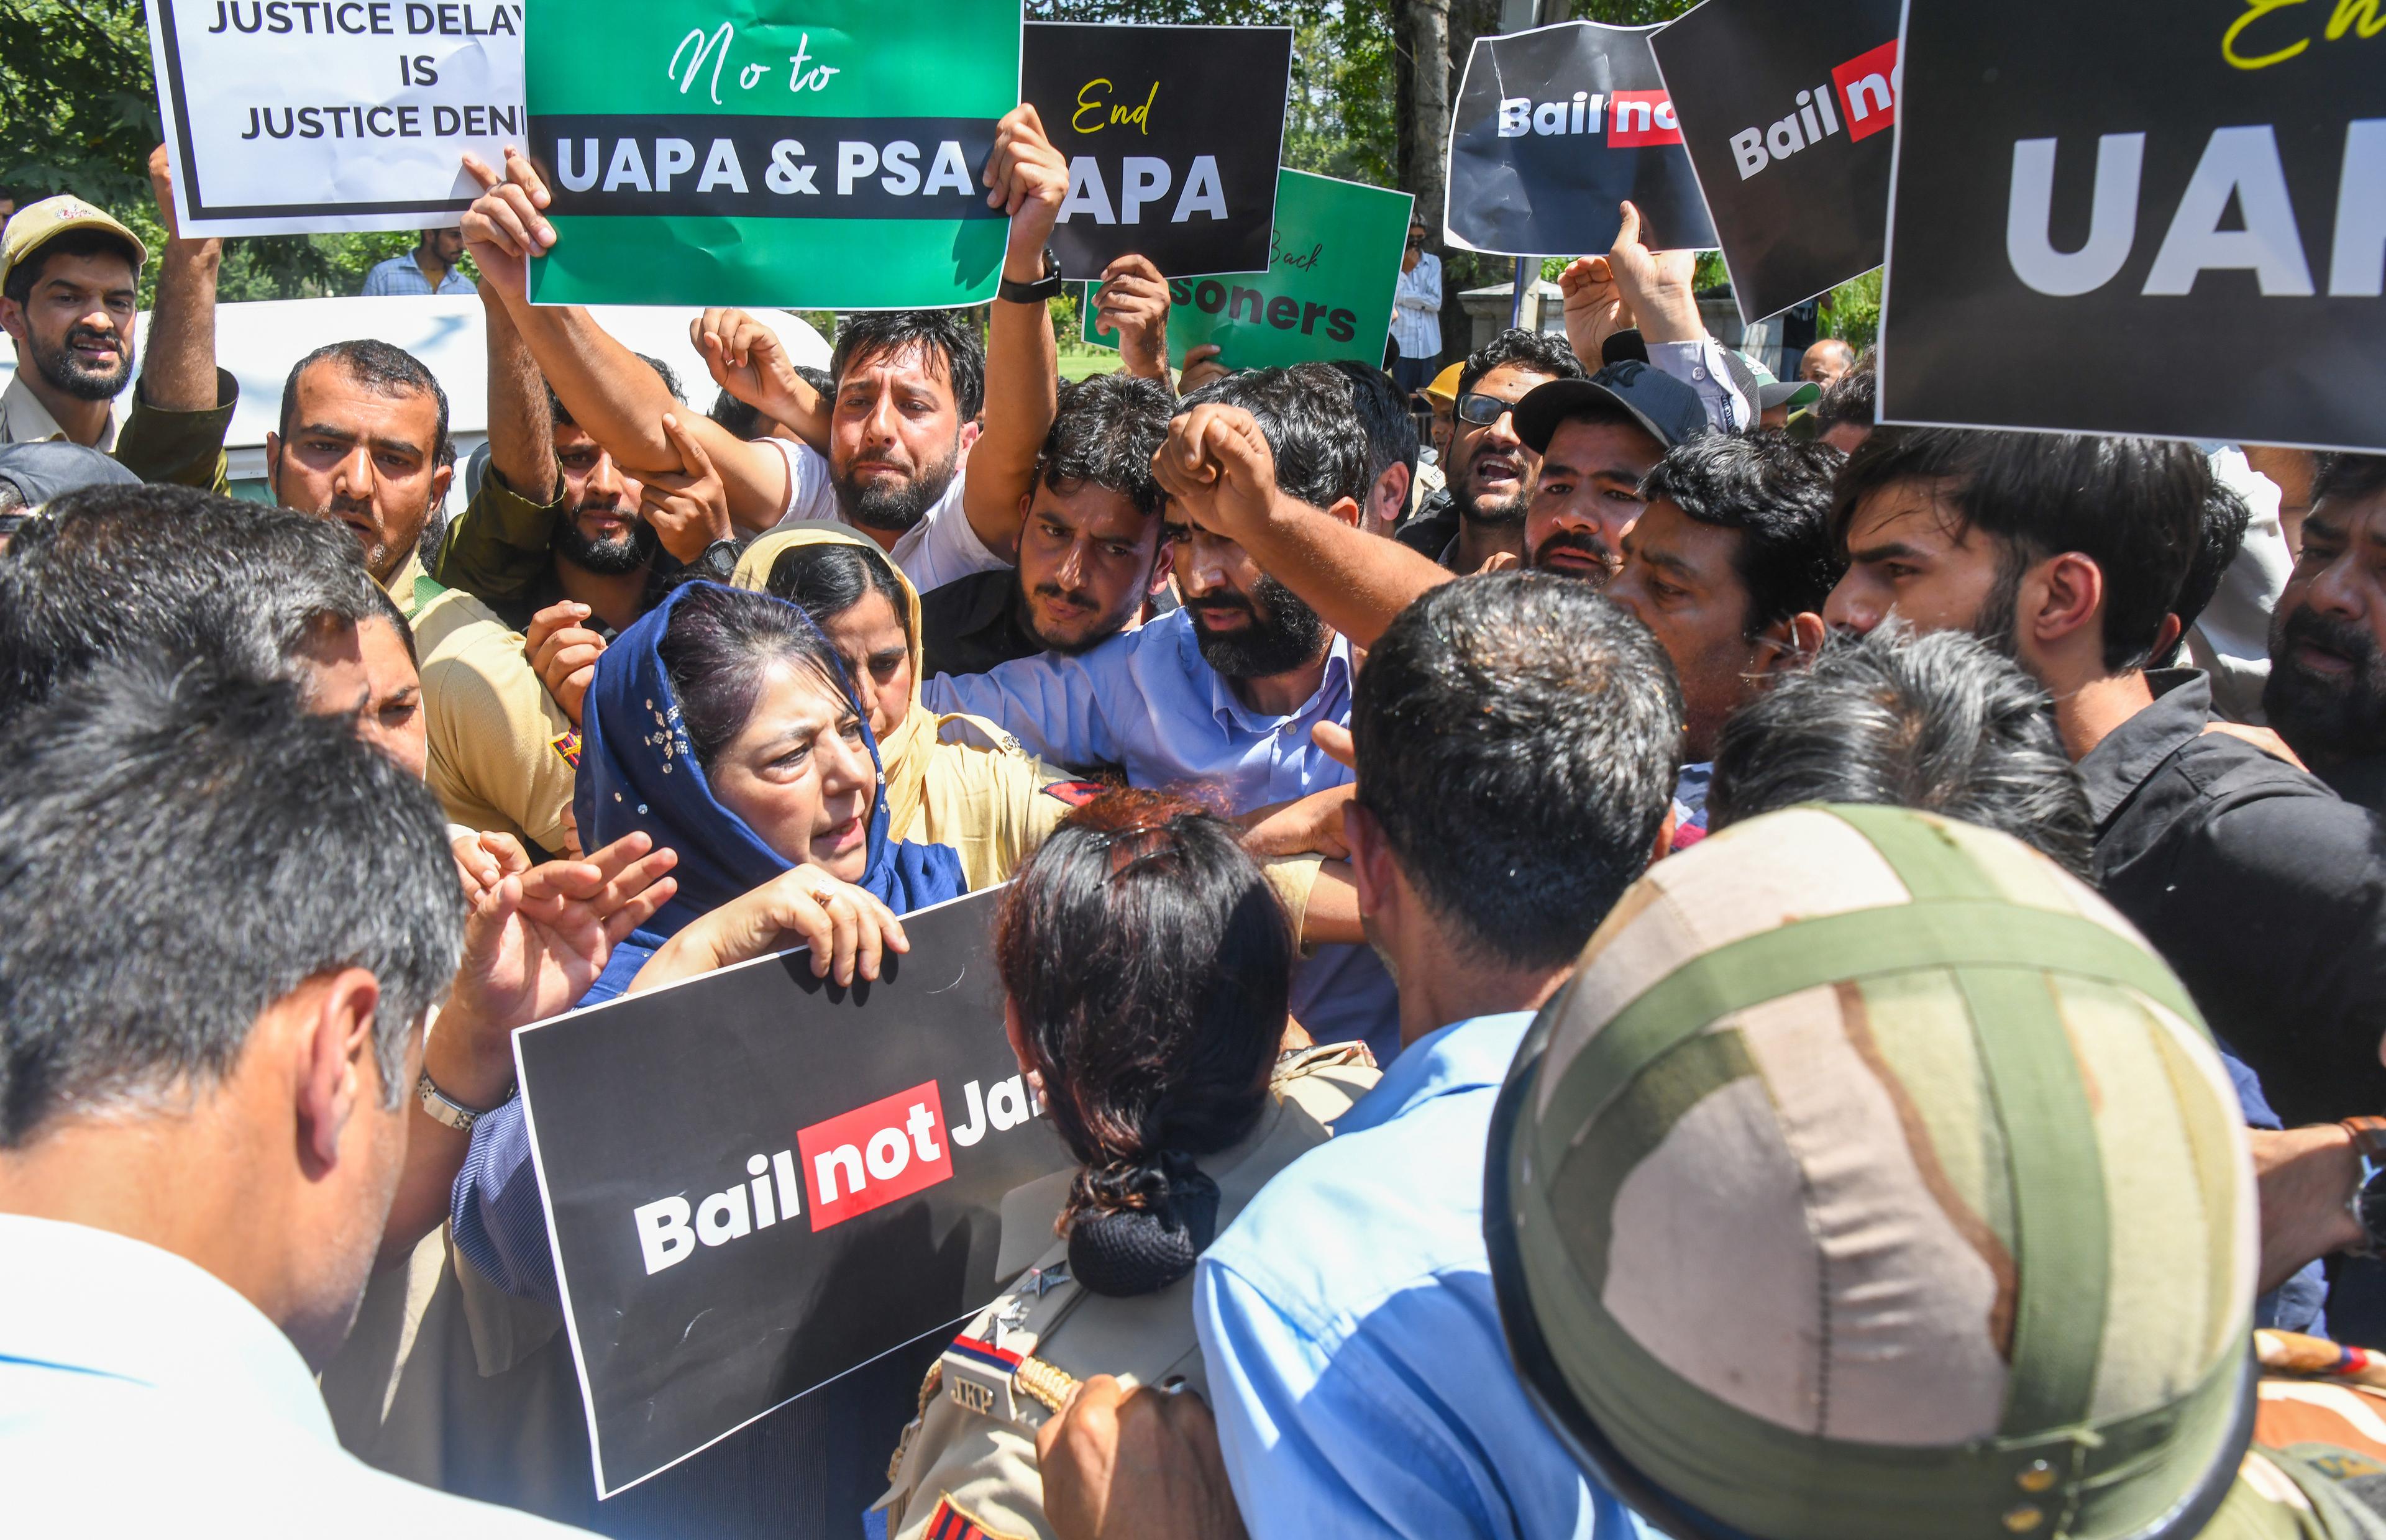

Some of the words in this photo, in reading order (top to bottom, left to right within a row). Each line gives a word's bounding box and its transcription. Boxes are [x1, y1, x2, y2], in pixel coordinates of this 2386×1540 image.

[208, 1, 394, 34] JUSTICE
[400, 55, 439, 86] IS
[668, 21, 771, 106] No
[788, 32, 840, 93] to
[241, 106, 422, 139] JUSTICE
[1072, 78, 1159, 135] End
[1497, 91, 1604, 138] Bail
[1729, 84, 1839, 181] Bail
[557, 138, 749, 193] UAPA
[764, 138, 821, 196] &
[837, 140, 976, 196] PSA
[1055, 155, 1228, 225] APA
[633, 1149, 800, 1275] Bail
[814, 1102, 941, 1205] not
[950, 1375, 994, 1415] JKP
